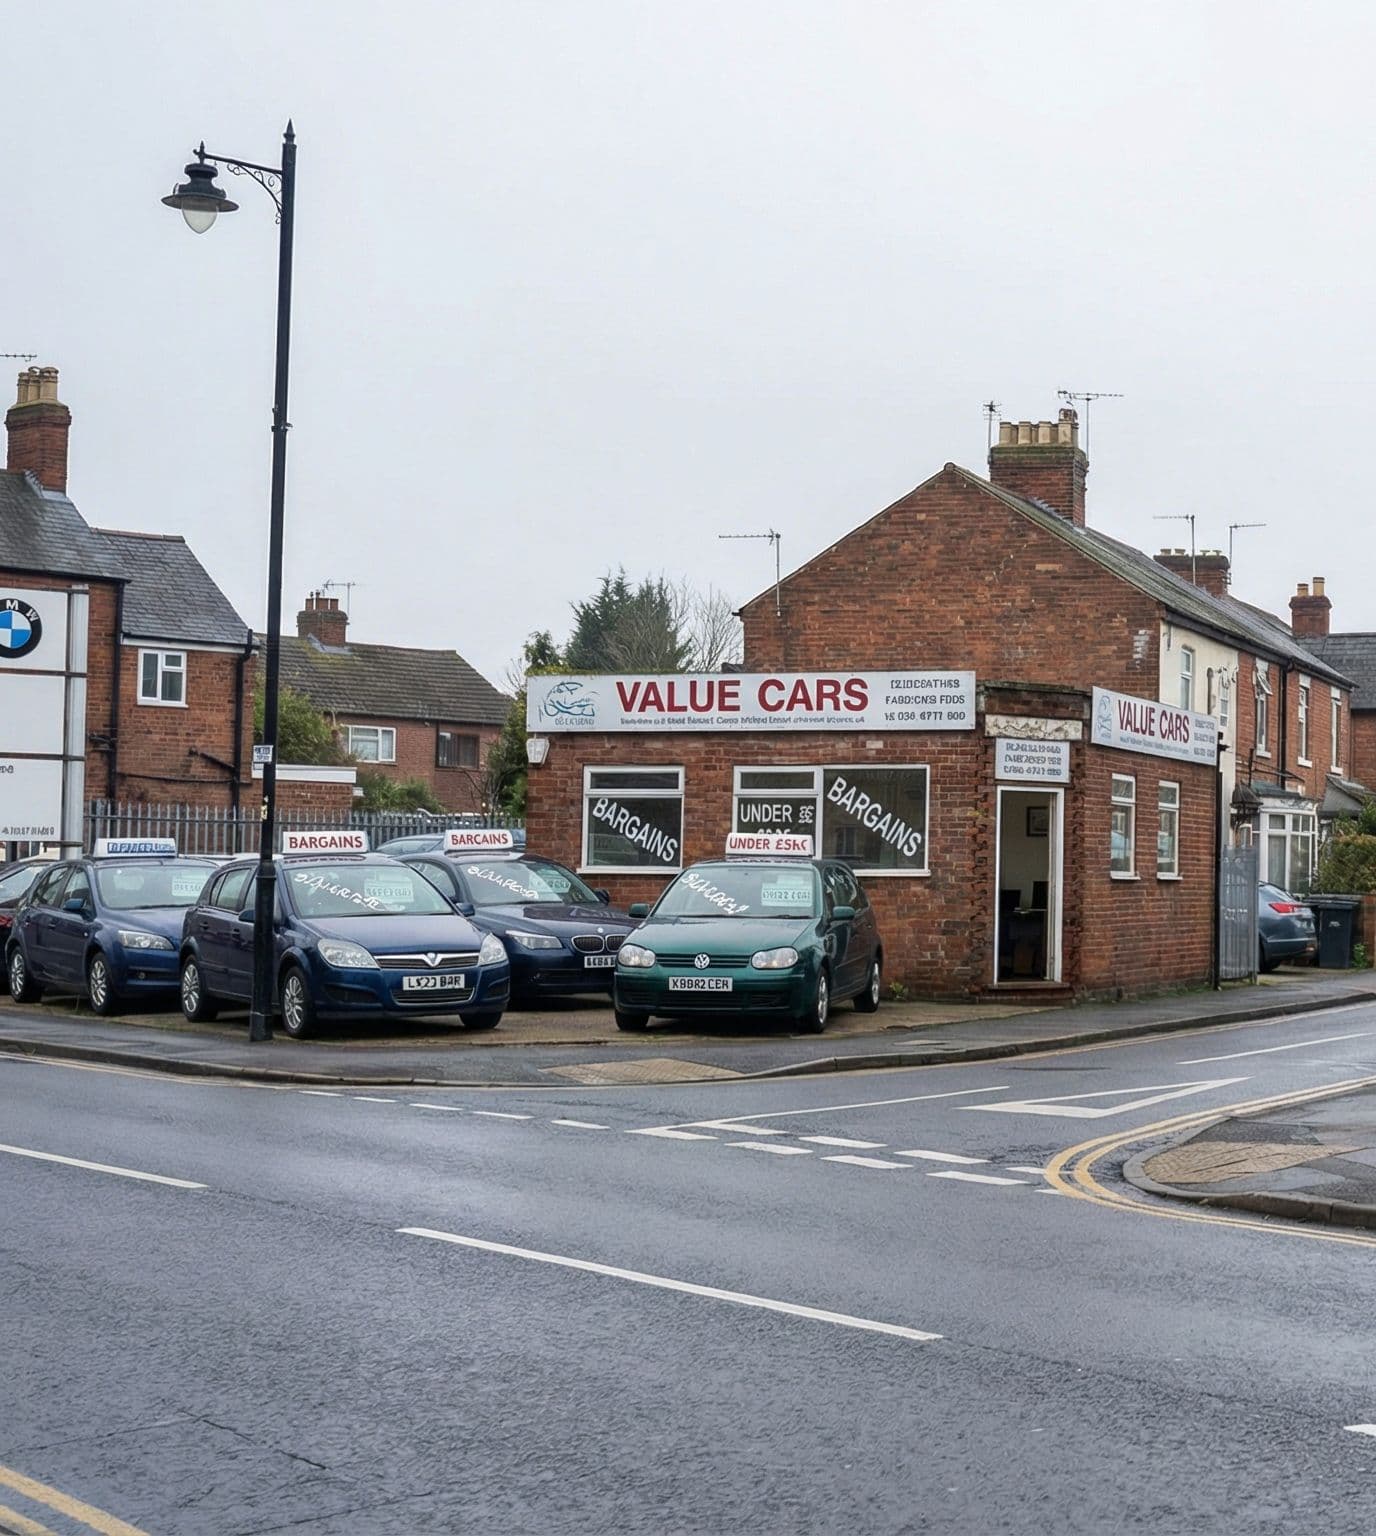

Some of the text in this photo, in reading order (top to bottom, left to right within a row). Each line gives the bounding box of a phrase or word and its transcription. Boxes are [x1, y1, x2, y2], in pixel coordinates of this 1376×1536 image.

[616, 678, 869, 713] VALUE CARS
[1118, 700, 1155, 736] VALUE
[1159, 710, 1190, 743] CARS
[592, 797, 679, 862] BARGAINS
[740, 803, 792, 823] UNDER
[826, 776, 922, 857] BARGAINS
[288, 836, 363, 849] BARGAINS
[729, 838, 771, 850] UNDER
